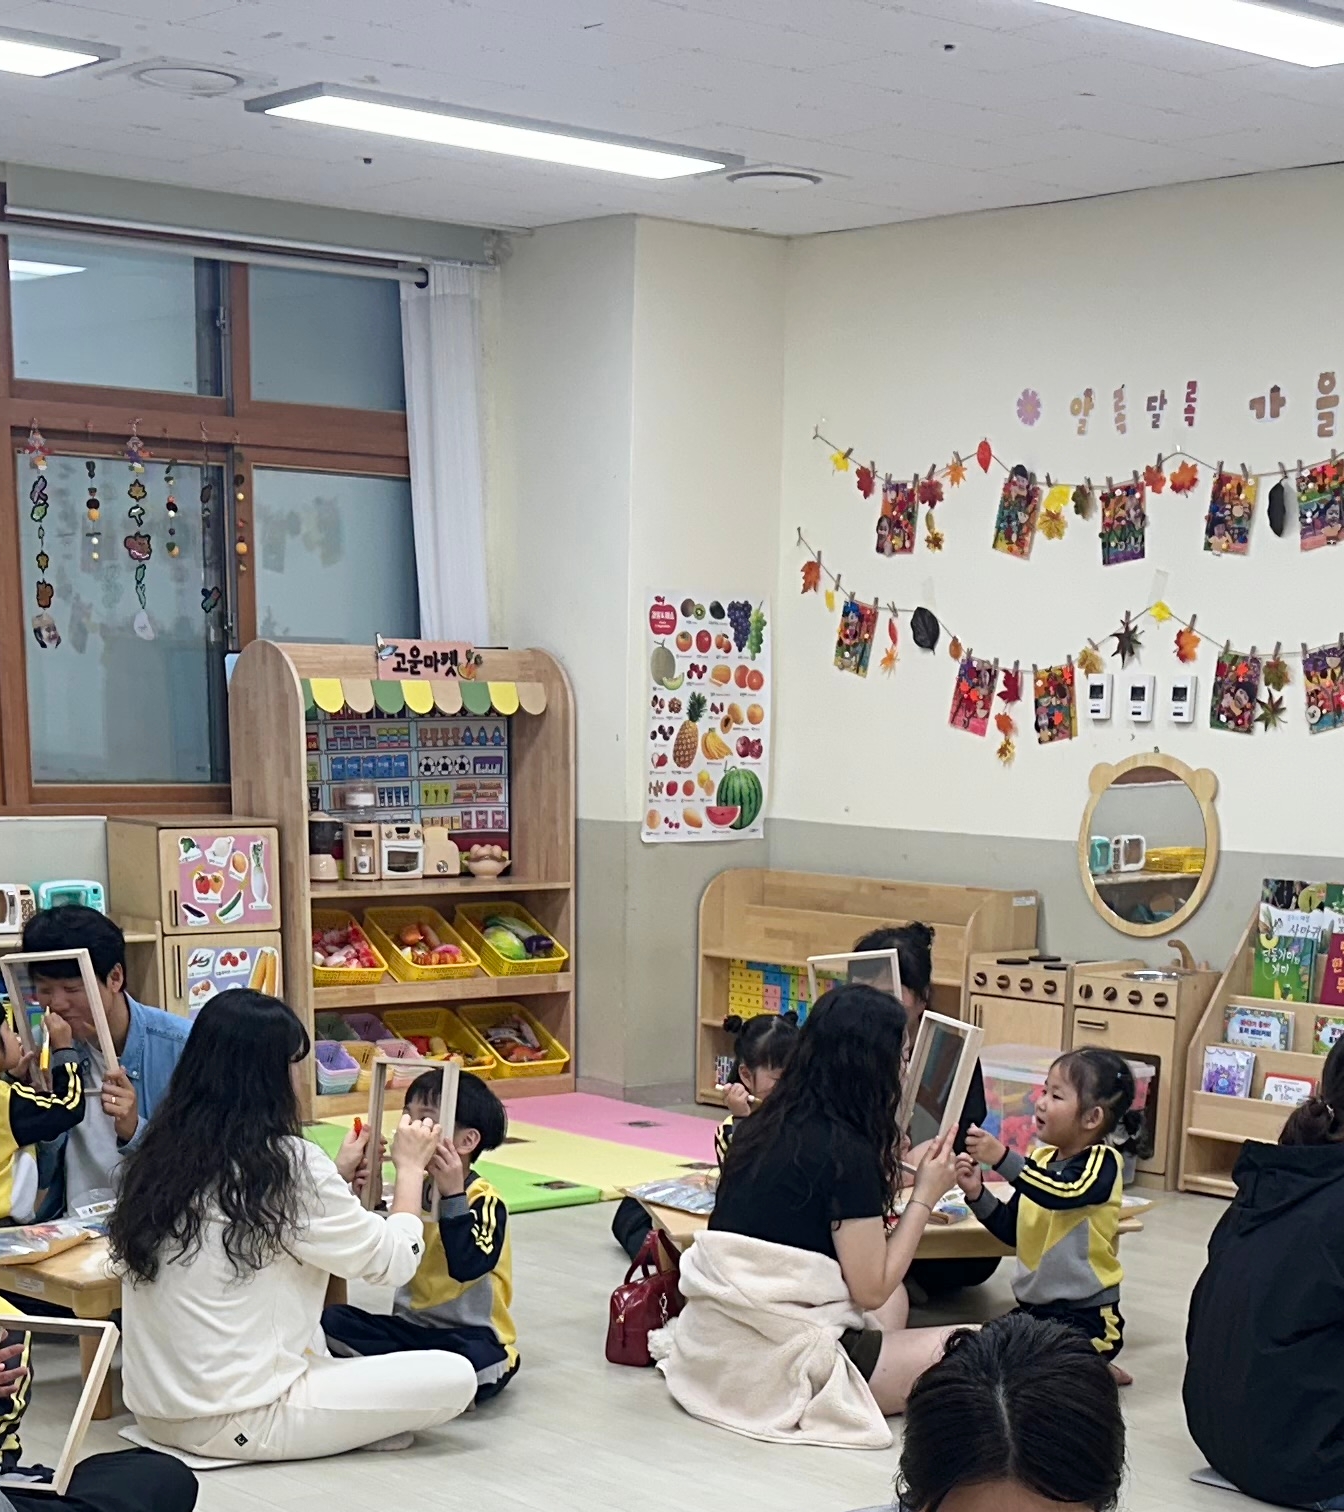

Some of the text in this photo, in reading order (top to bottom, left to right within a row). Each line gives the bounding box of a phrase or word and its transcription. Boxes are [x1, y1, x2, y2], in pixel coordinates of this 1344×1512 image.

[1069, 371, 1340, 438] 알록달록 가을
[392, 645, 458, 677] 고운마켓
[1331, 957, 1344, 974] 한
